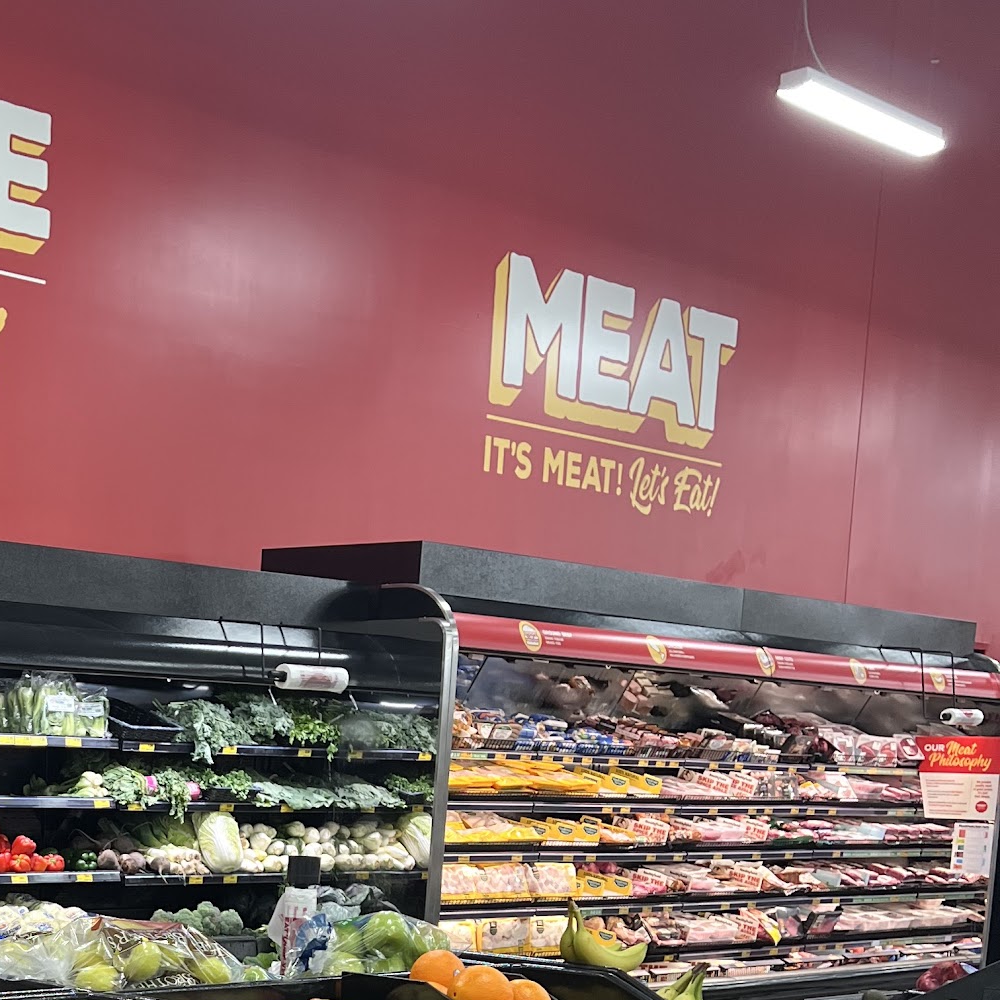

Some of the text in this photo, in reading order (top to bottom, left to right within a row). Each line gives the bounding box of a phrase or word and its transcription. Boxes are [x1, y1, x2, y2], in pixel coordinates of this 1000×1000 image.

[488, 251, 739, 449] MEAT
[483, 435, 721, 517] IT'S MEAT! Let's Eat!
[924, 740, 977, 757] OUR Meat
[929, 752, 992, 772] Philosophy
